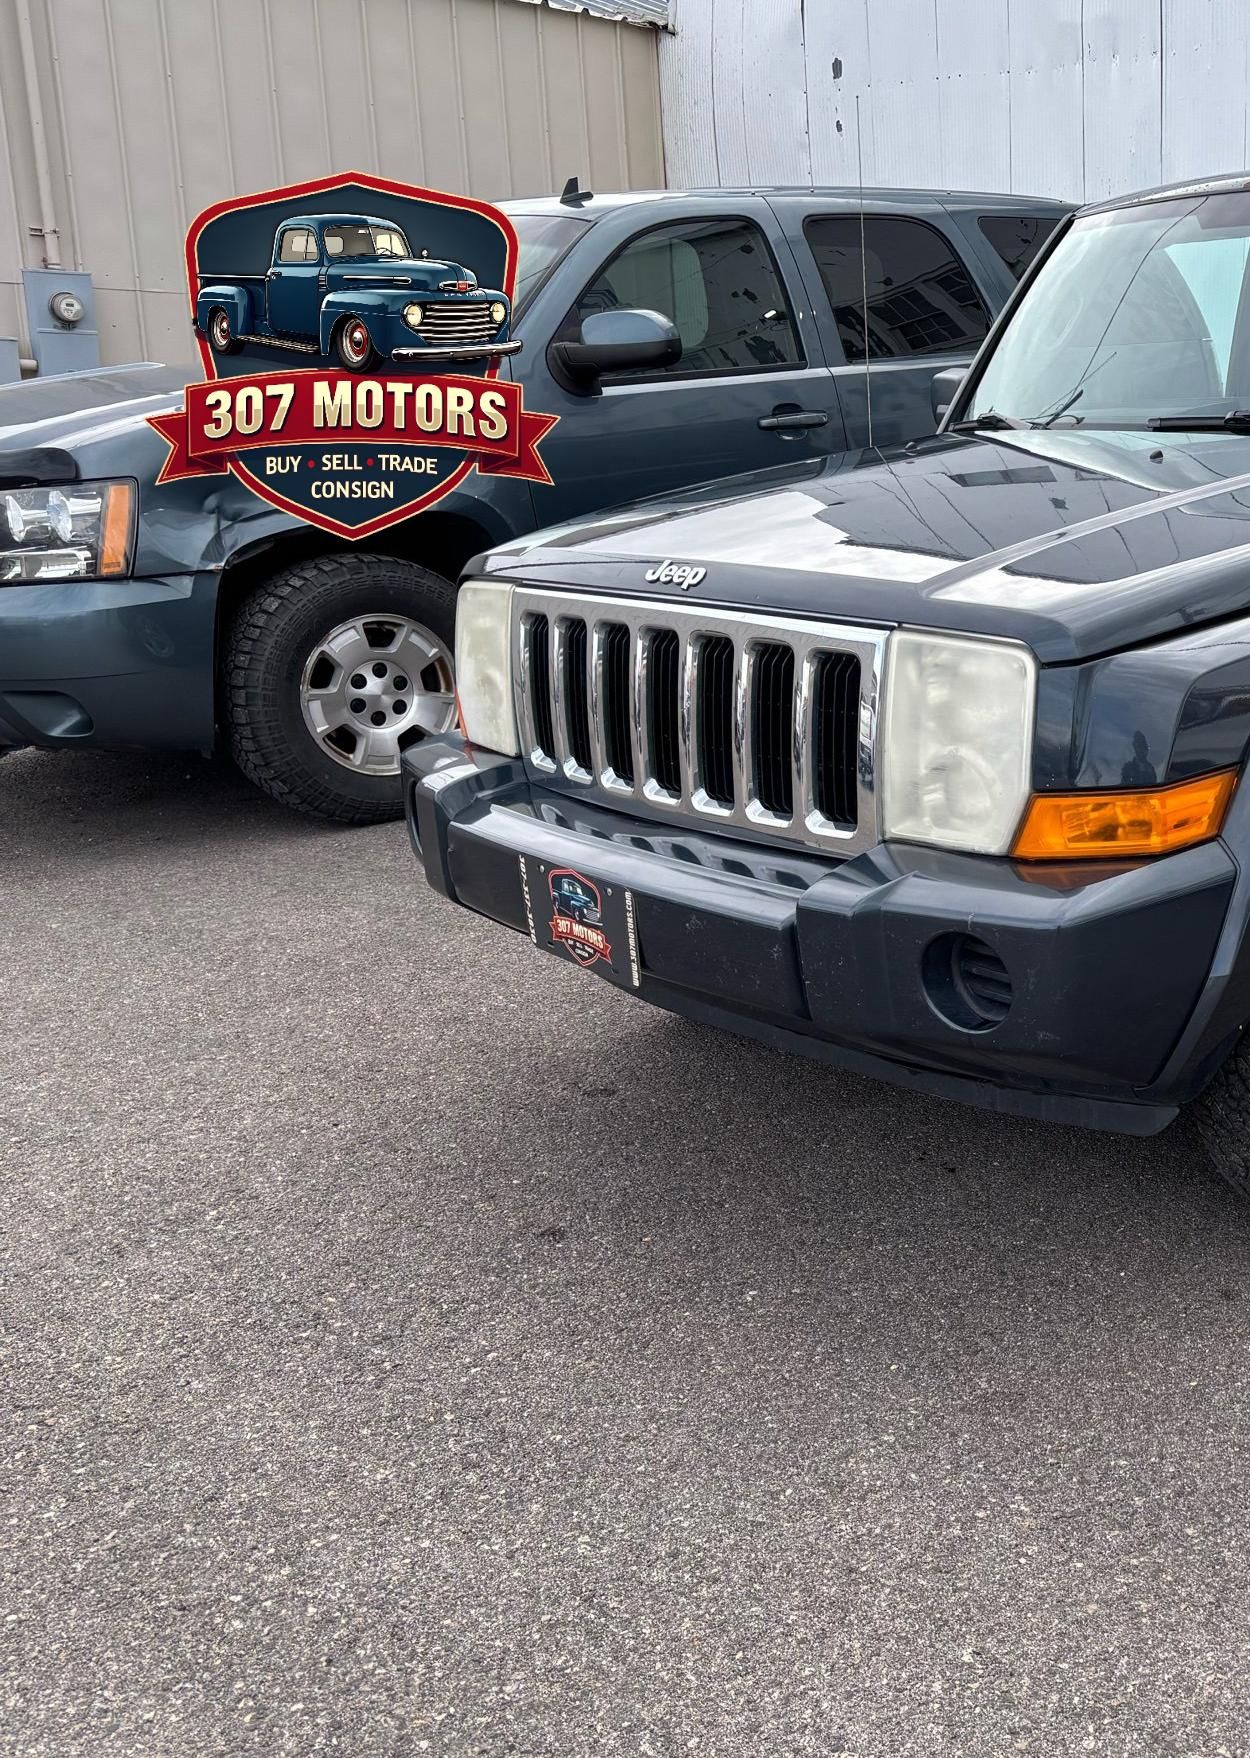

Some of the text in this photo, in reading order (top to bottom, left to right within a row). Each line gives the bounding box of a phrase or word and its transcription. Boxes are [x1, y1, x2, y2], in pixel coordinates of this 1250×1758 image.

[645, 559, 707, 590] Jeep
[556, 919, 571, 933] 307
[572, 923, 604, 949] MOTORS
